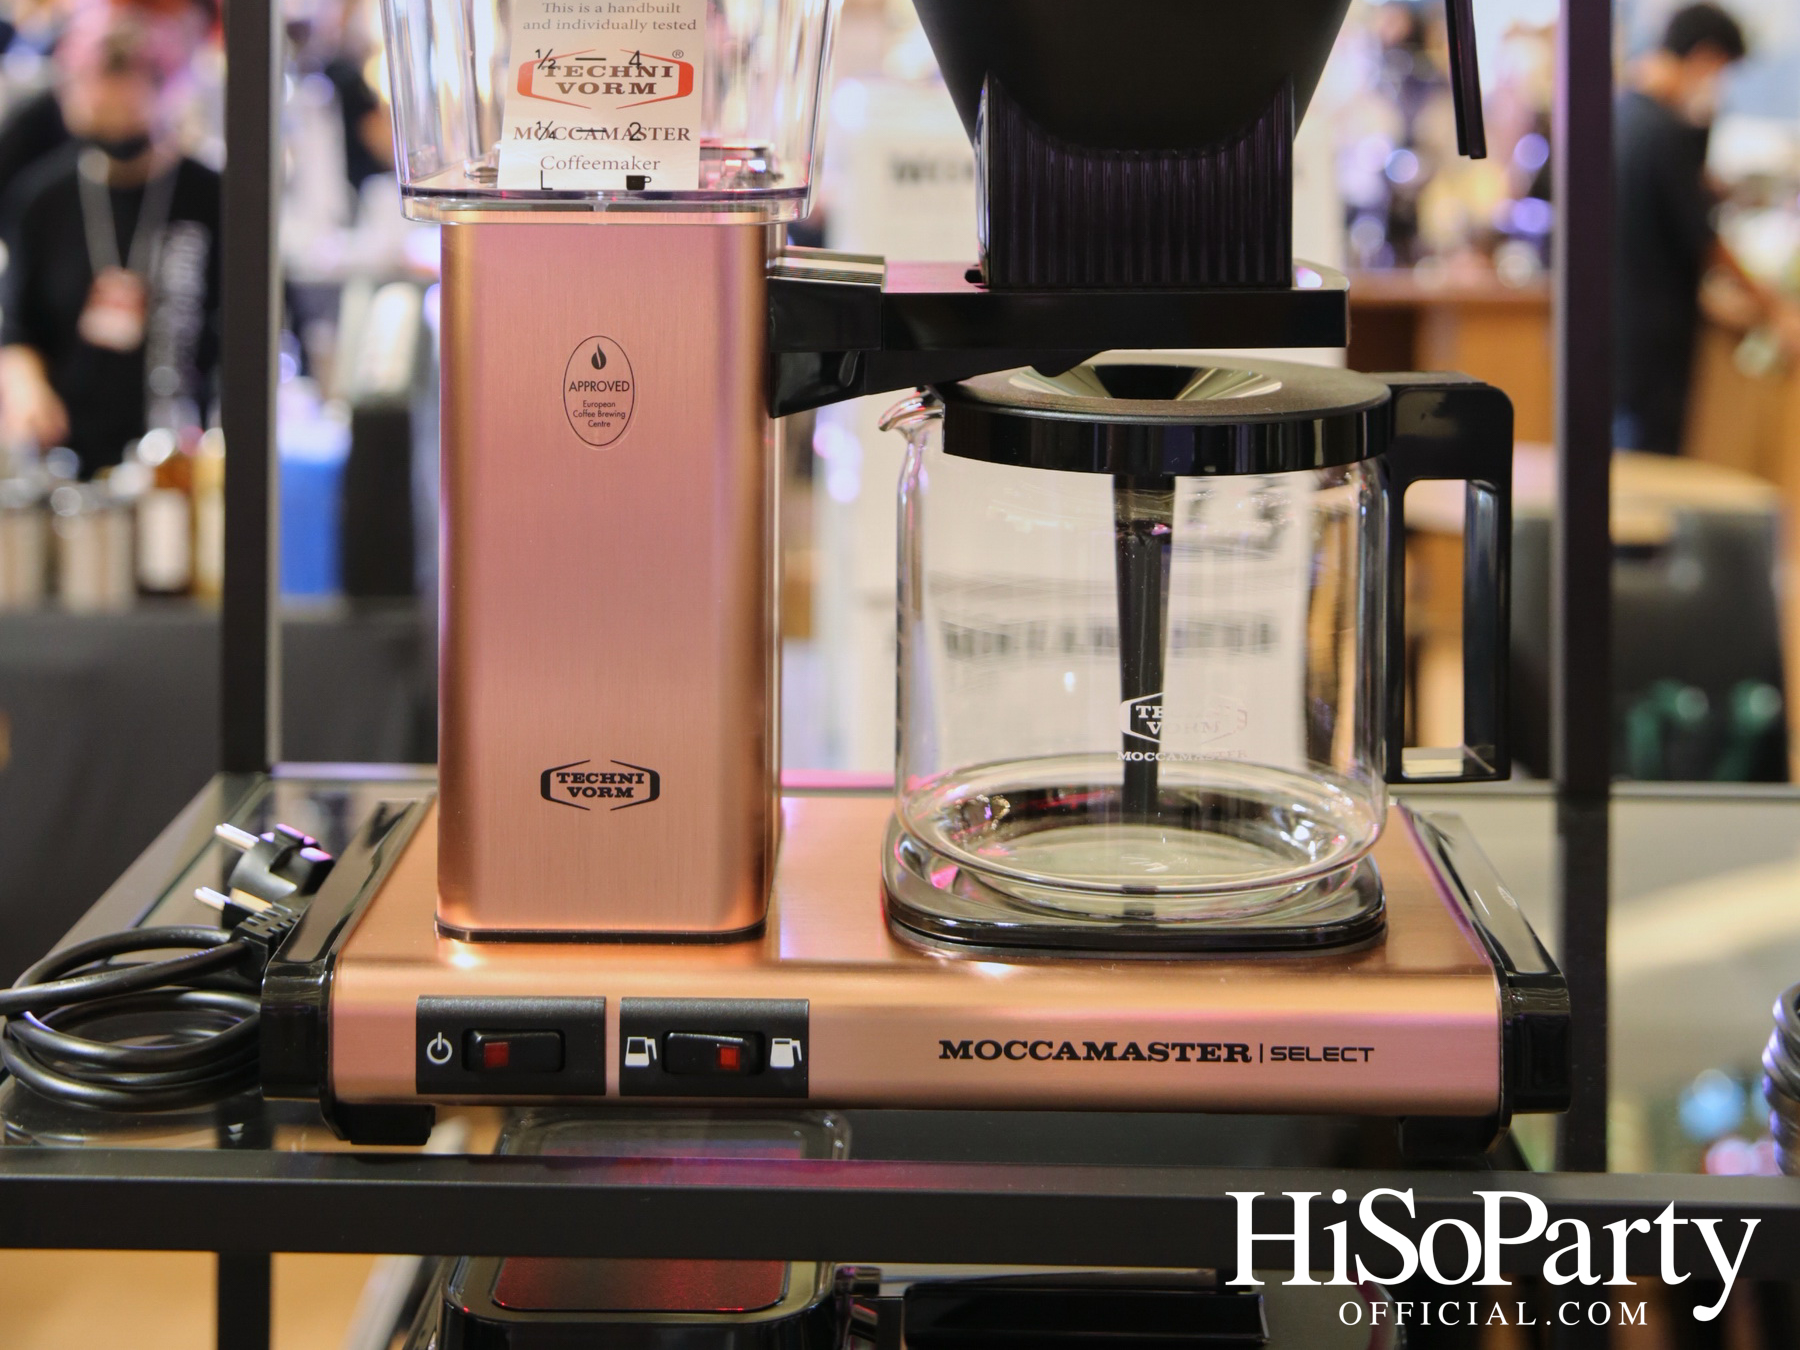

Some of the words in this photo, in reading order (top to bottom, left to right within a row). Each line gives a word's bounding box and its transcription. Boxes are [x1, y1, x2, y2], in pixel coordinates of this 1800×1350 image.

[542, 3, 574, 14] This
[578, 3, 590, 14] is
[594, 6, 603, 14] a
[607, 3, 681, 14] handbuilt
[522, 20, 551, 31] and
[556, 20, 648, 34] individually
[652, 20, 697, 31] tested
[628, 50, 642, 70] 4
[541, 65, 674, 79] TECHNI
[555, 82, 657, 95] VORM
[513, 126, 692, 141] MOCCAMASTER
[629, 122, 642, 141] 2
[540, 155, 661, 170] Coffeemaker
[568, 380, 630, 392] APPROVED
[582, 400, 616, 410] European
[572, 409, 596, 418] Coffee
[597, 410, 626, 420] Brewing
[588, 420, 611, 428] Centre
[556, 772, 645, 784] TECHNI
[566, 786, 634, 798] VORM
[938, 1039, 1253, 1063] MOCCAMASTER
[1269, 1045, 1376, 1063] SELECT
